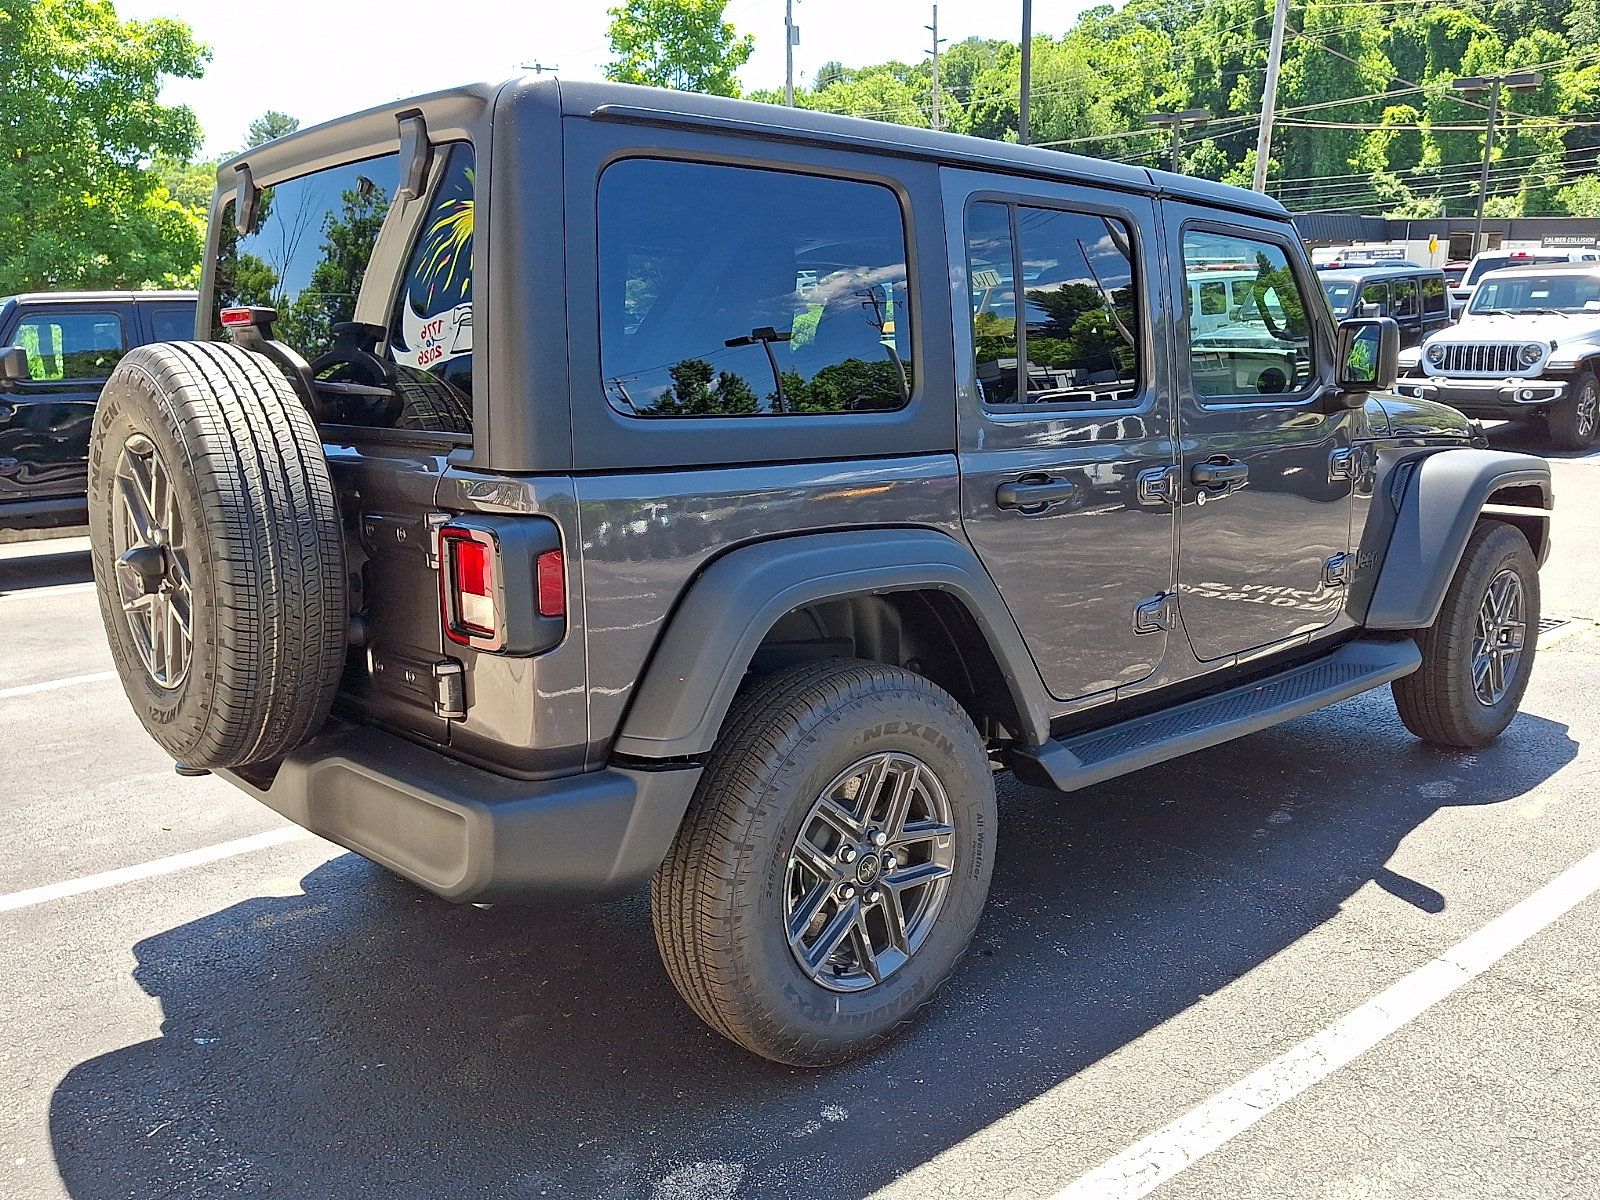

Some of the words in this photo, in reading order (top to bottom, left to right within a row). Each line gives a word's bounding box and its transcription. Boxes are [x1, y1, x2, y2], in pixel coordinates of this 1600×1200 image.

[92, 401, 119, 492] NEXEN
[863, 721, 955, 756] NEXEN
[974, 813, 985, 881] All-Weather
